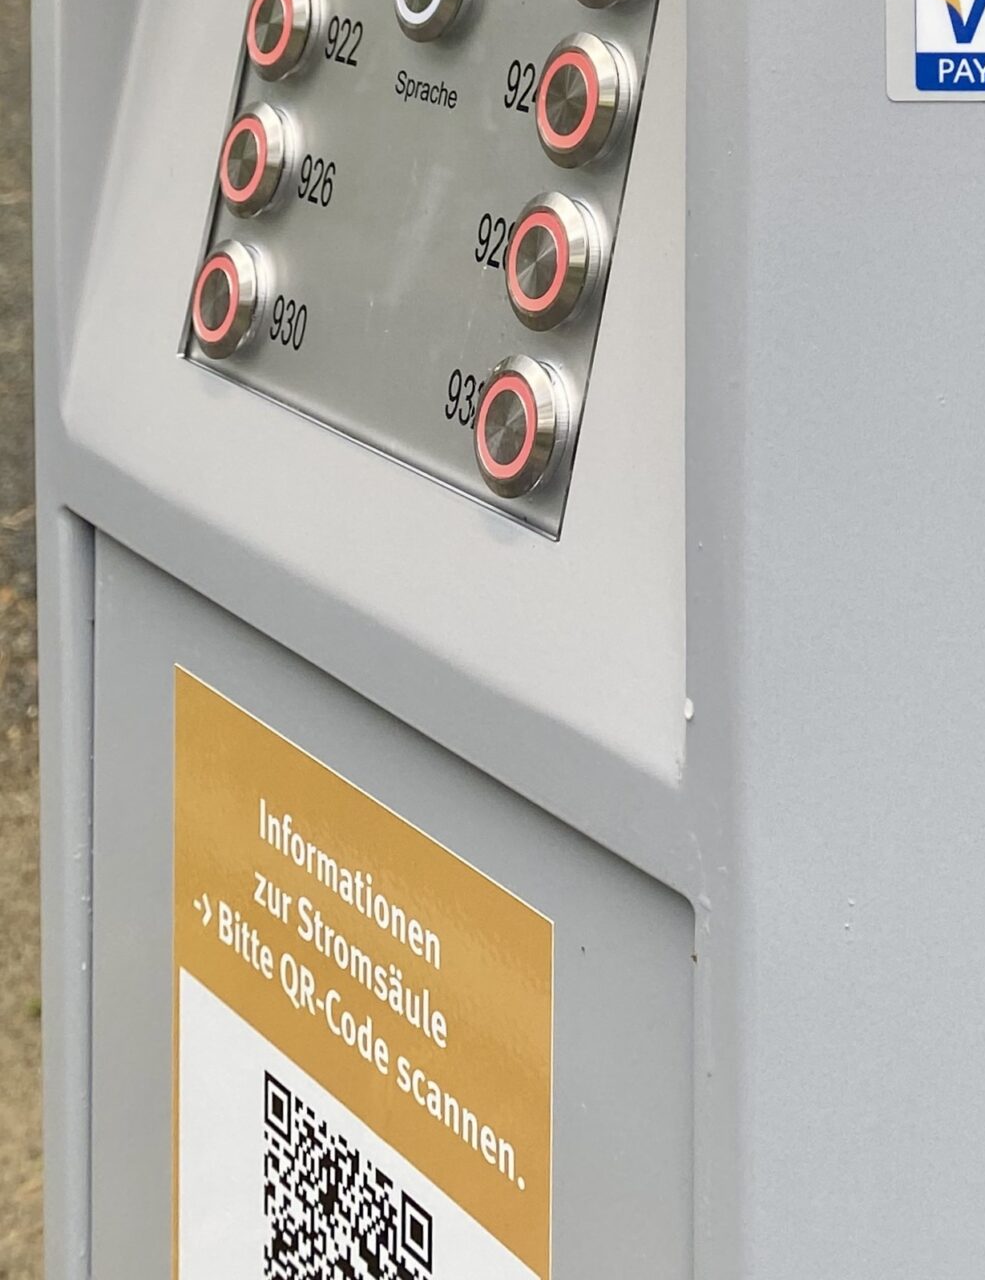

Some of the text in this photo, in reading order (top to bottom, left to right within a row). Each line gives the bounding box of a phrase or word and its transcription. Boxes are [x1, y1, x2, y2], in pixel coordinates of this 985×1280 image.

[324, 15, 364, 66] 922
[394, 70, 459, 109] Sprache
[504, 59, 538, 114] 92
[296, 153, 336, 207] 926
[474, 212, 515, 271] 92
[268, 294, 308, 351] 930
[444, 368, 484, 430] 93
[258, 797, 442, 970] Informationen
[253, 871, 448, 1049] zur Stromsäule
[218, 901, 527, 1191] Bitte QR-Code scannen.
